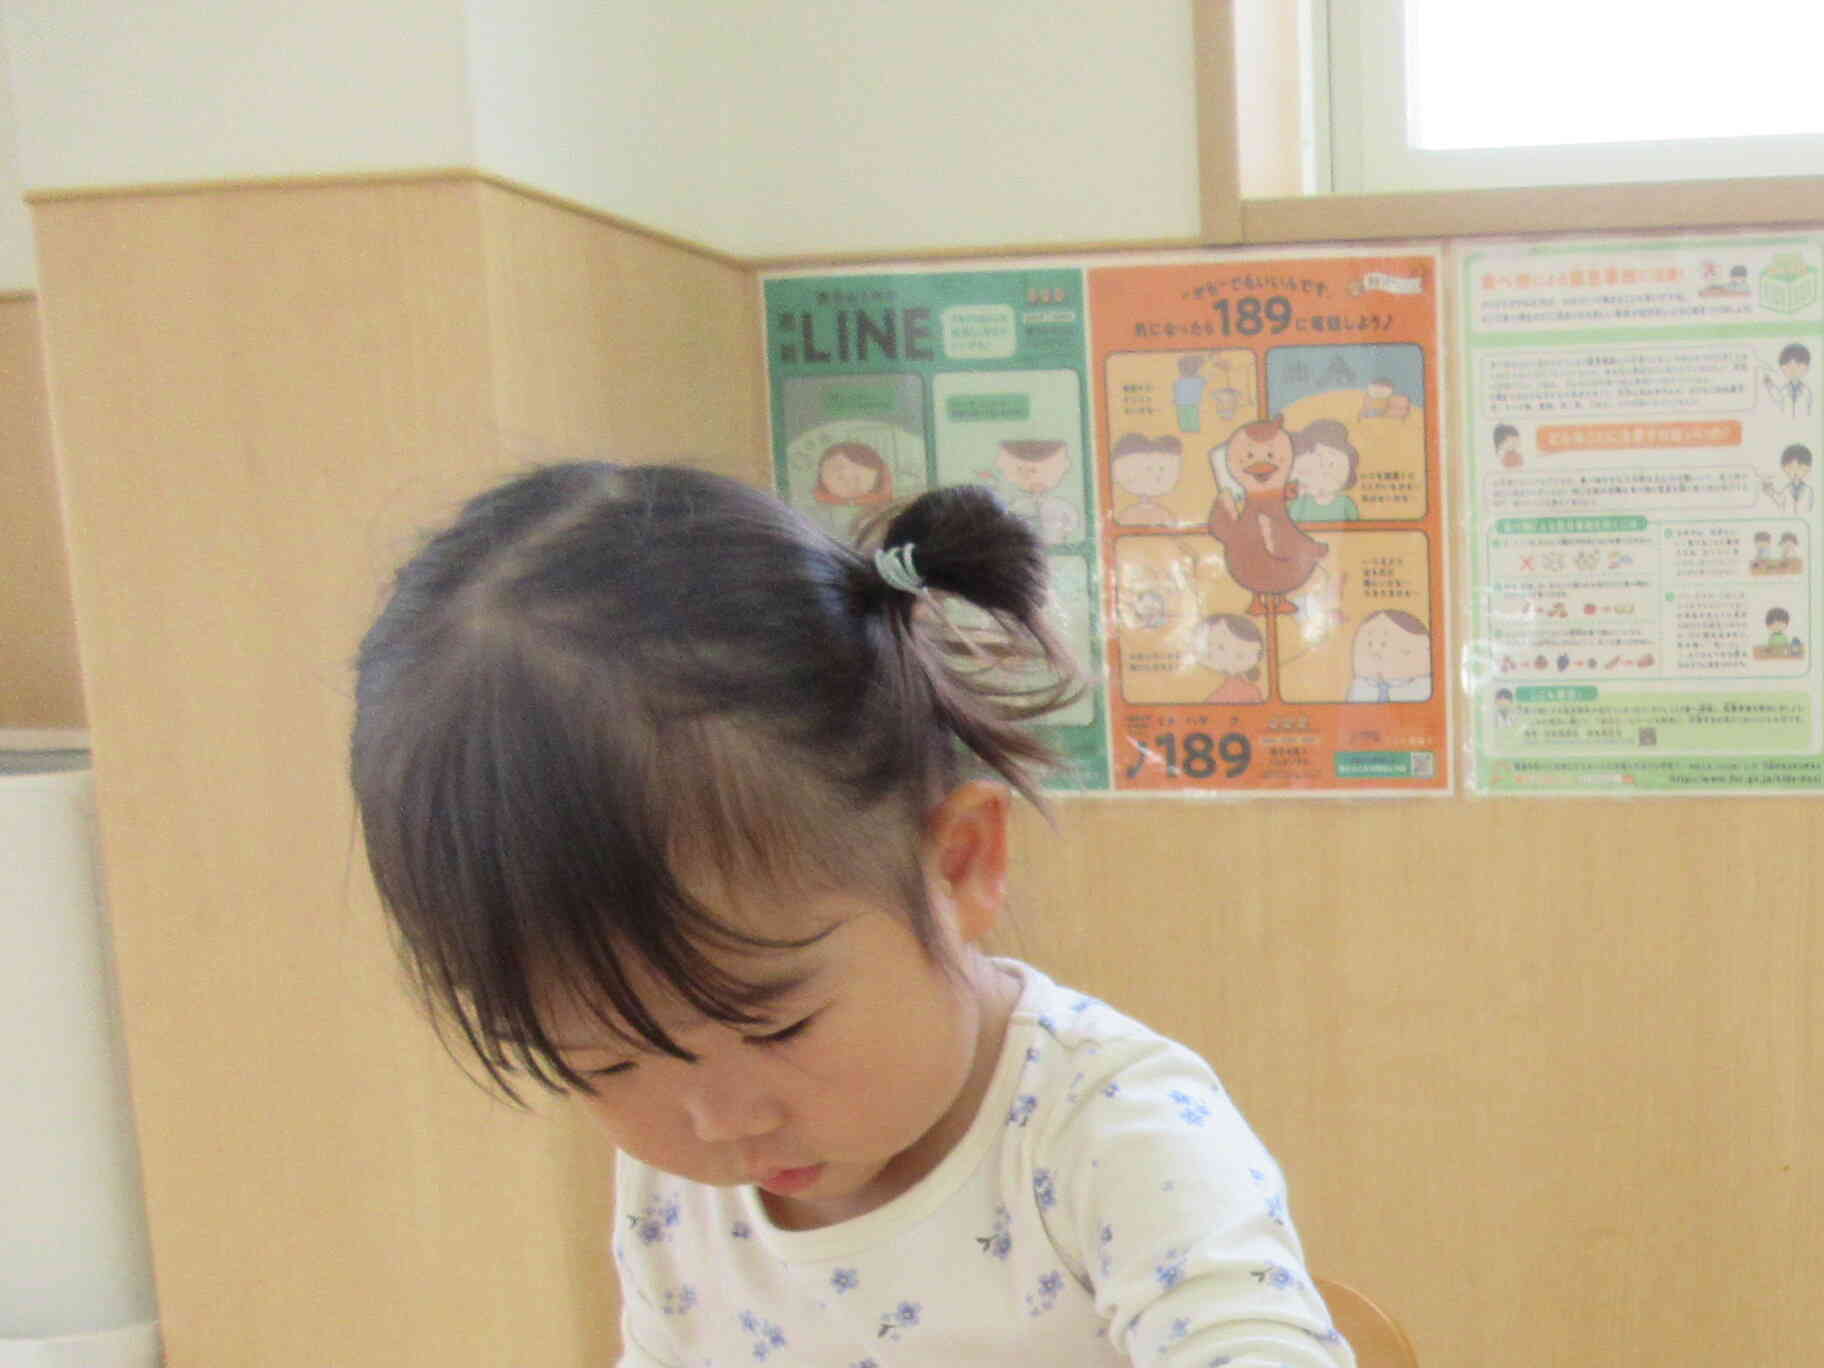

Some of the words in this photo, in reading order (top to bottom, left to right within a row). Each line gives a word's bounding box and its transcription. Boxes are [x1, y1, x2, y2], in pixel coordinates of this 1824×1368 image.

[802, 307, 935, 362] LINE
[1212, 297, 1292, 336] 189
[1155, 732, 1252, 778] 189
